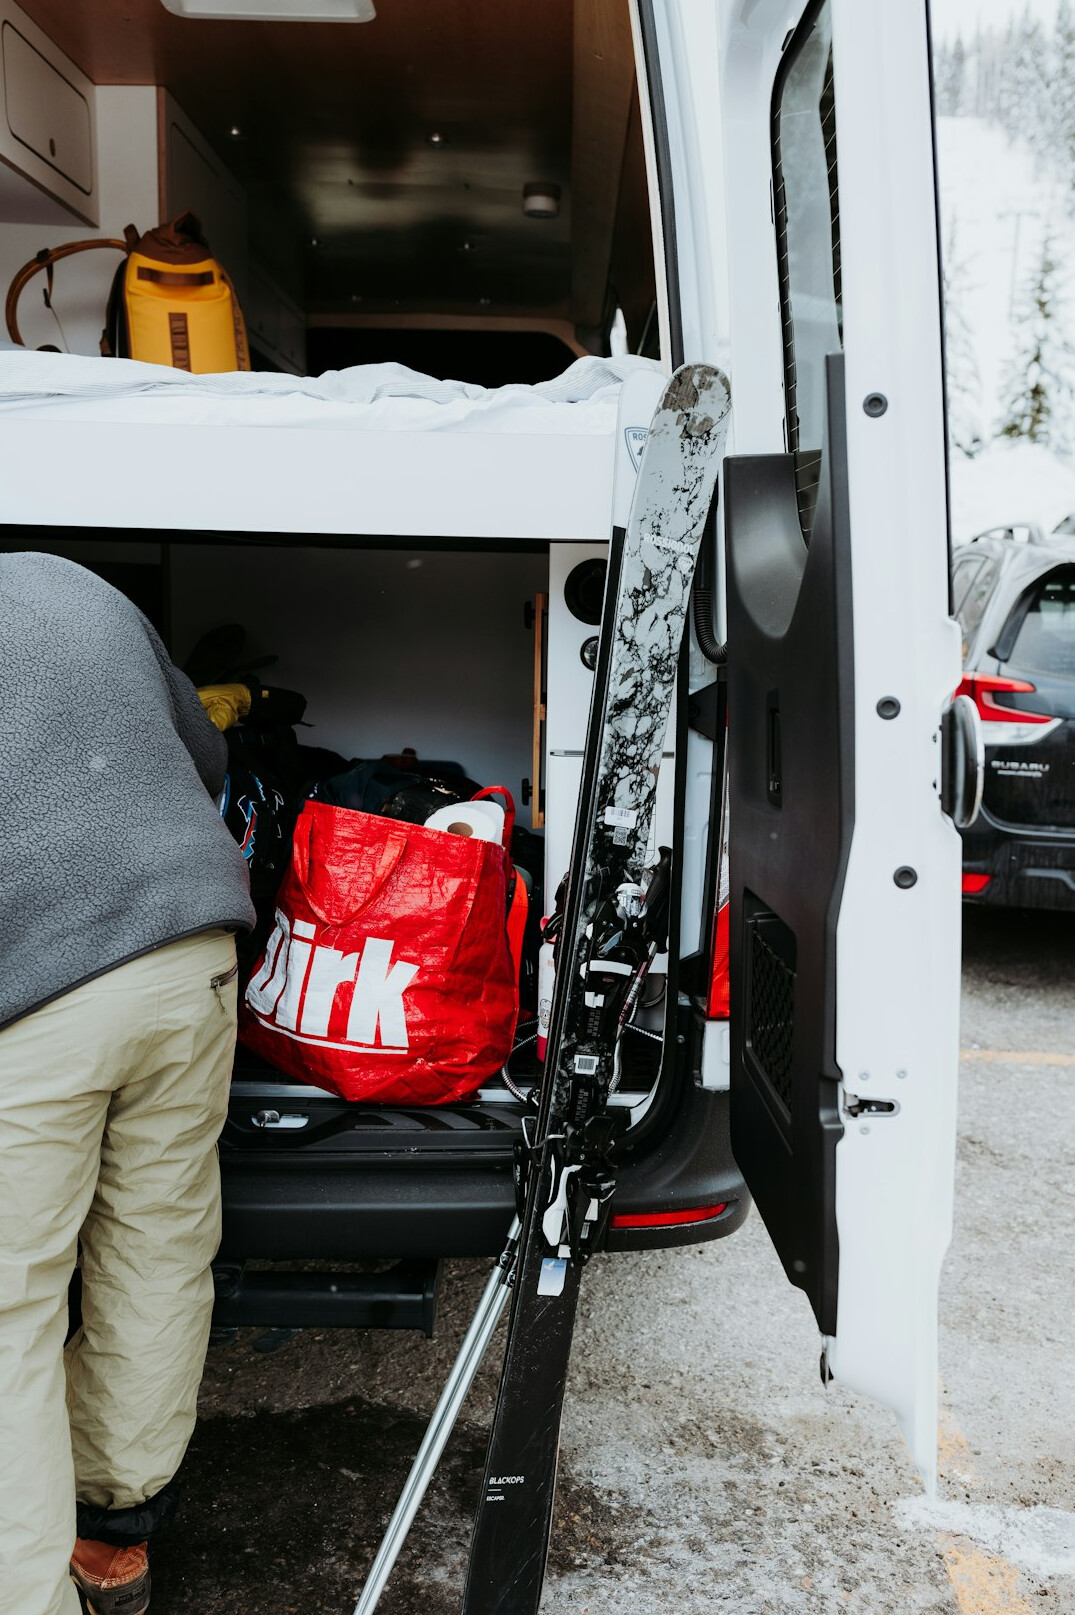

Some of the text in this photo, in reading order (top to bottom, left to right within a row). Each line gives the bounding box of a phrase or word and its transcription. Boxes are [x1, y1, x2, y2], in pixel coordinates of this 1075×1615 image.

[643, 533, 696, 555] ROSSIGNOL
[990, 760, 1050, 772] SUBARU
[245, 907, 420, 1048] Dirk
